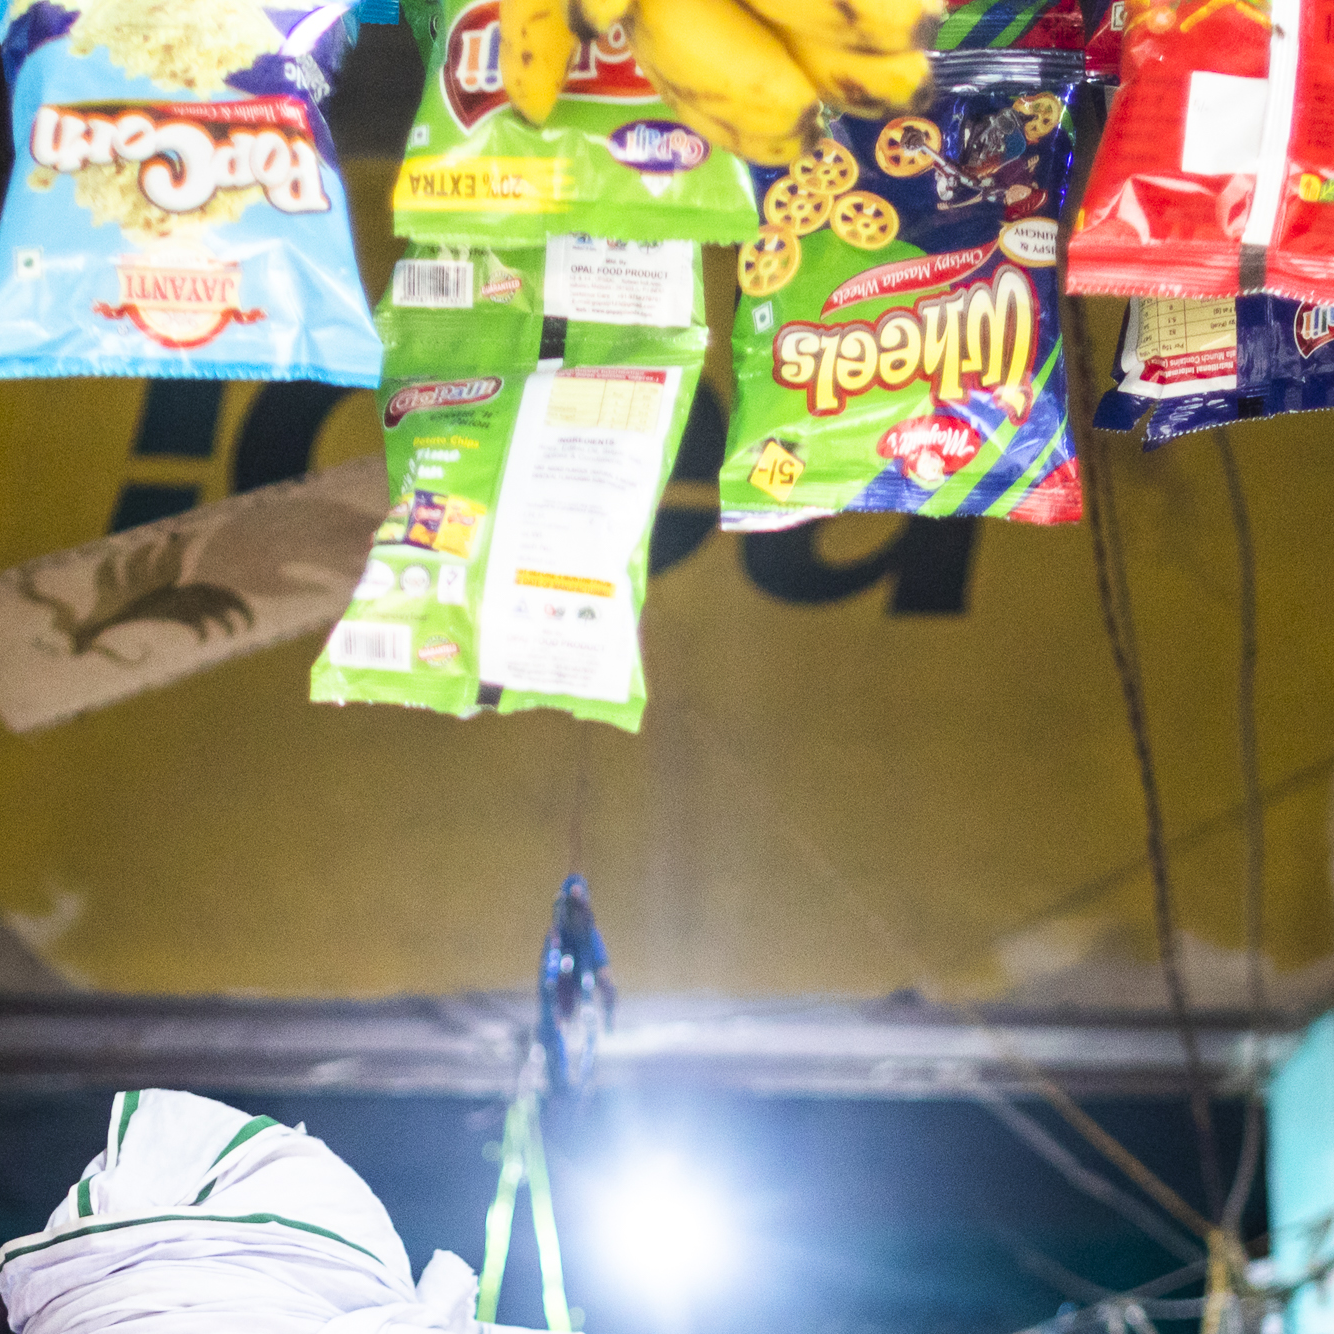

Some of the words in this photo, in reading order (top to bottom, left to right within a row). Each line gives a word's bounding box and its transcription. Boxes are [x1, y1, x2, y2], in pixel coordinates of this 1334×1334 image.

[30, 106, 330, 214] PopCorn
[408, 173, 476, 198] EXTRA
[1014, 228, 1056, 240] UNCHY
[934, 249, 984, 273] Chrispy
[1033, 244, 1056, 255] ISPY
[570, 265, 593, 274] OPAL
[597, 265, 623, 276] FOOD
[625, 268, 669, 280] PRODUCT
[882, 261, 930, 286] Masala
[124, 274, 274, 303] JAYANTI
[831, 278, 879, 306] Wheels
[779, 269, 1033, 418] Wheels
[1169, 355, 1200, 367] Contains
[1196, 361, 1234, 373] Nutritional
[757, 459, 796, 485] 5/-
